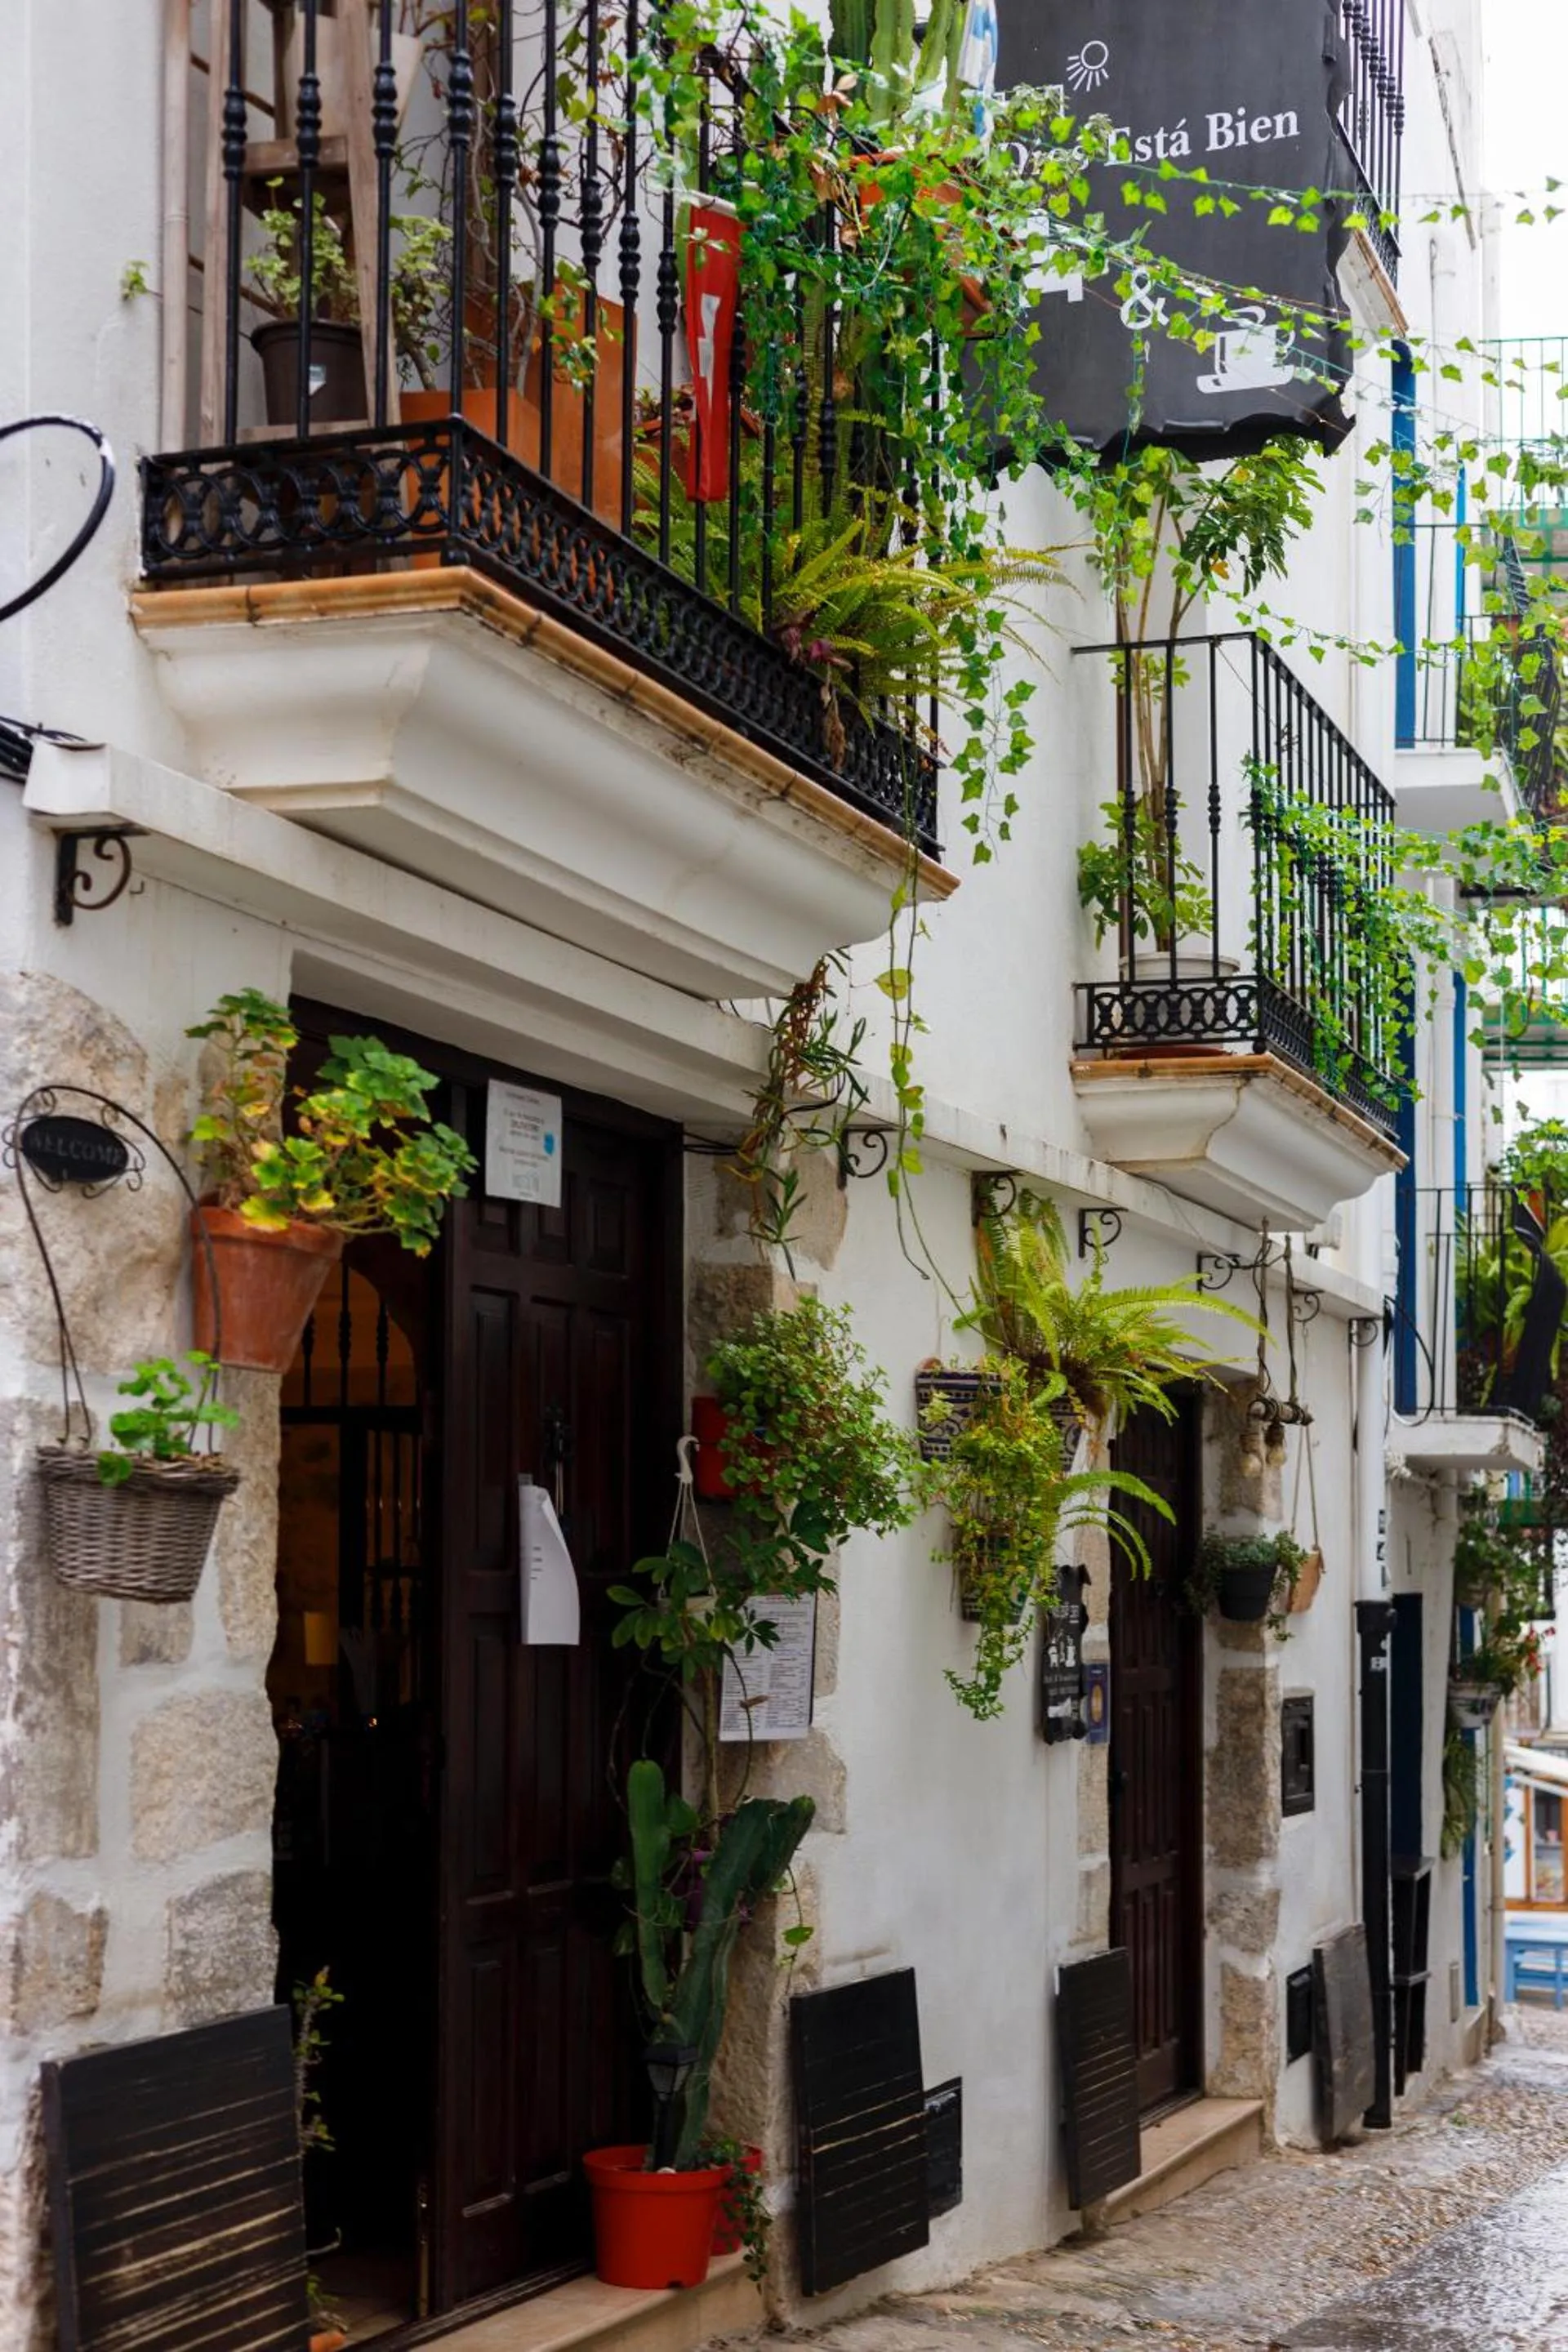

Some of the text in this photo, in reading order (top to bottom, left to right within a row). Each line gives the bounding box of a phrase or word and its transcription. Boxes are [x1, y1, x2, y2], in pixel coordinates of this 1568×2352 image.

[1104, 118, 1191, 167] Está
[1205, 107, 1300, 152] Bien
[1120, 267, 1169, 329] &
